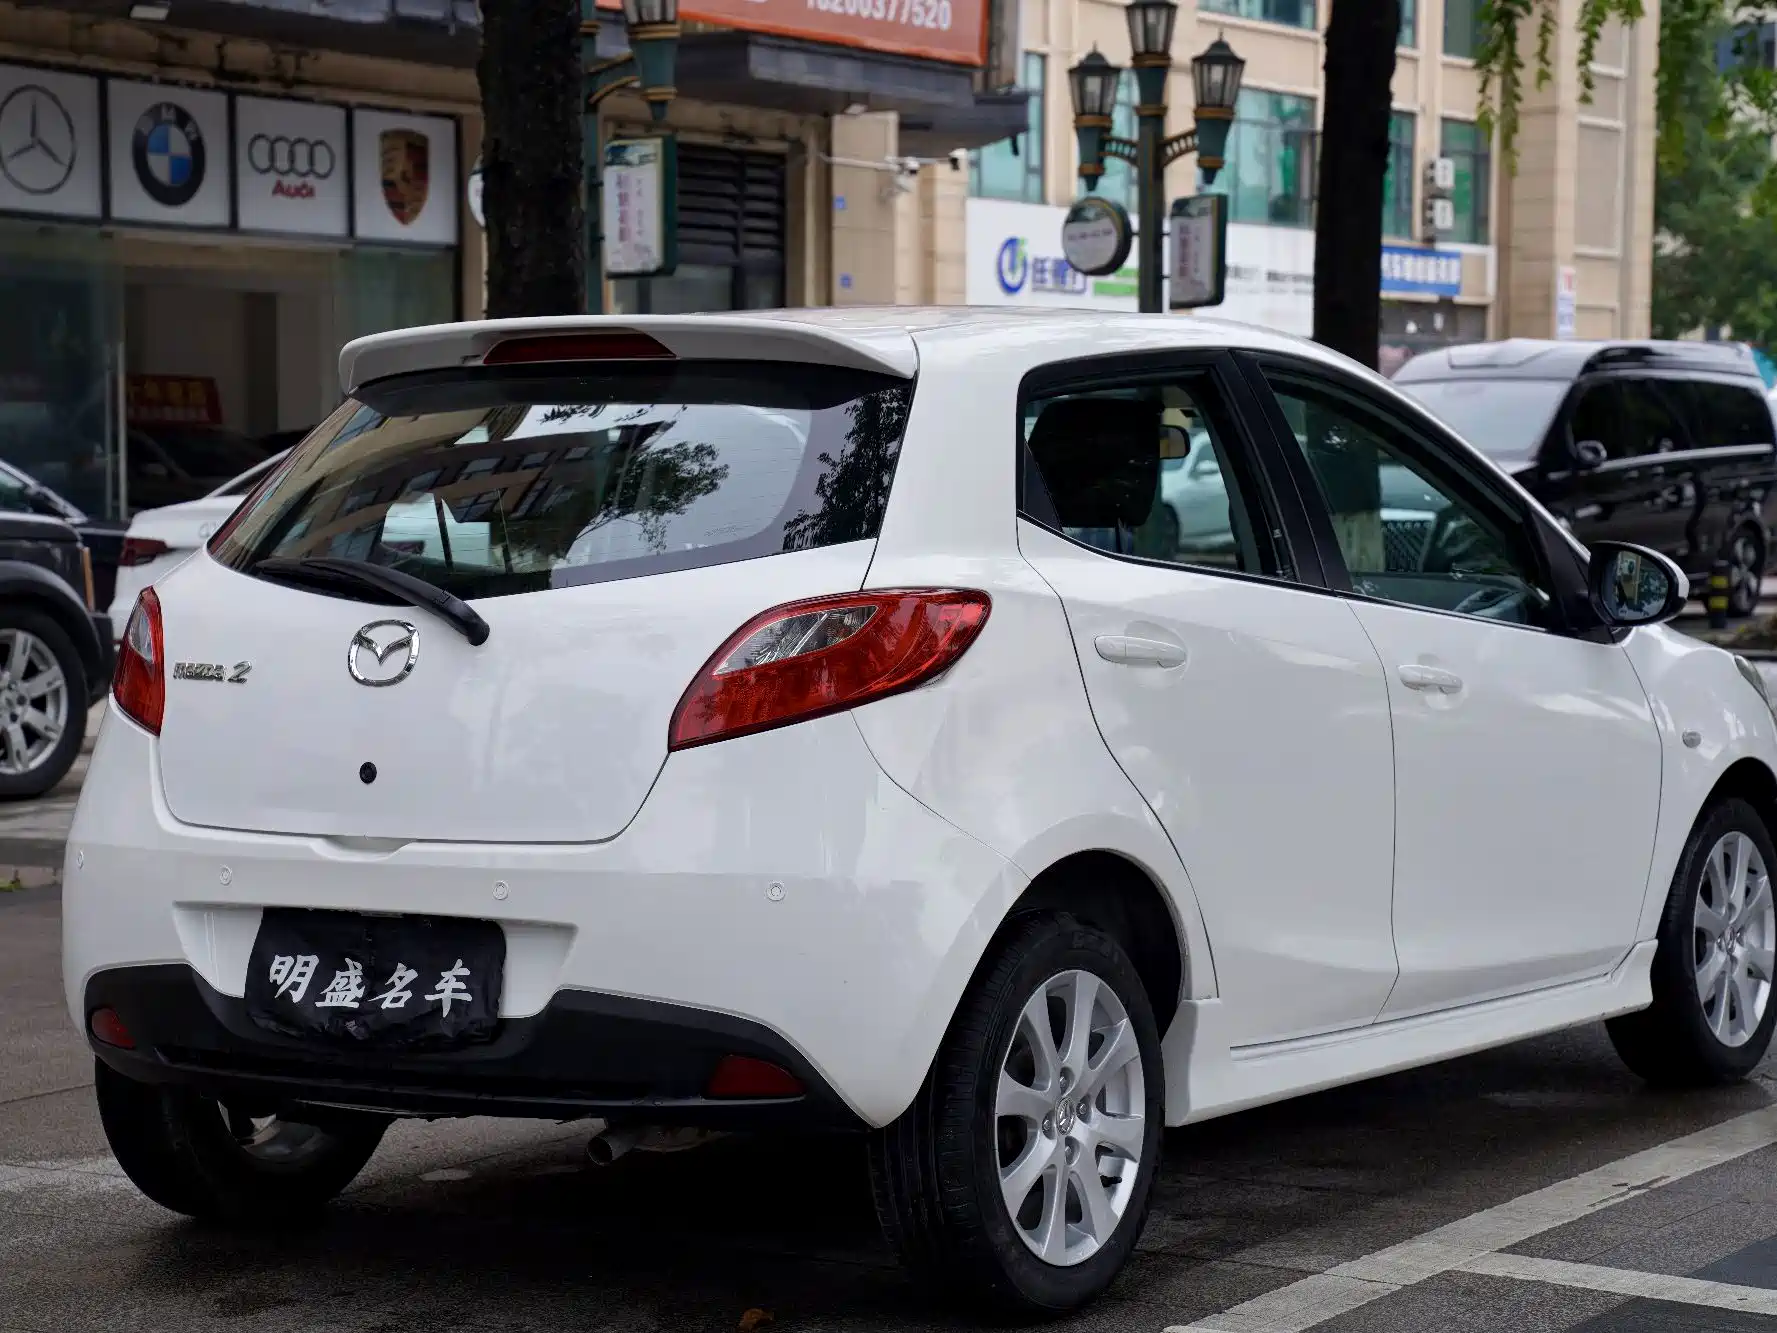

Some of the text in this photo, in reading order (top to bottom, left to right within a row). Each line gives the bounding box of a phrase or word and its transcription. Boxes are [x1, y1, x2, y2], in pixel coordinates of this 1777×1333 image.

[271, 179, 316, 199] Audi
[227, 660, 253, 684] 2
[269, 954, 473, 1018] 明盛名车
